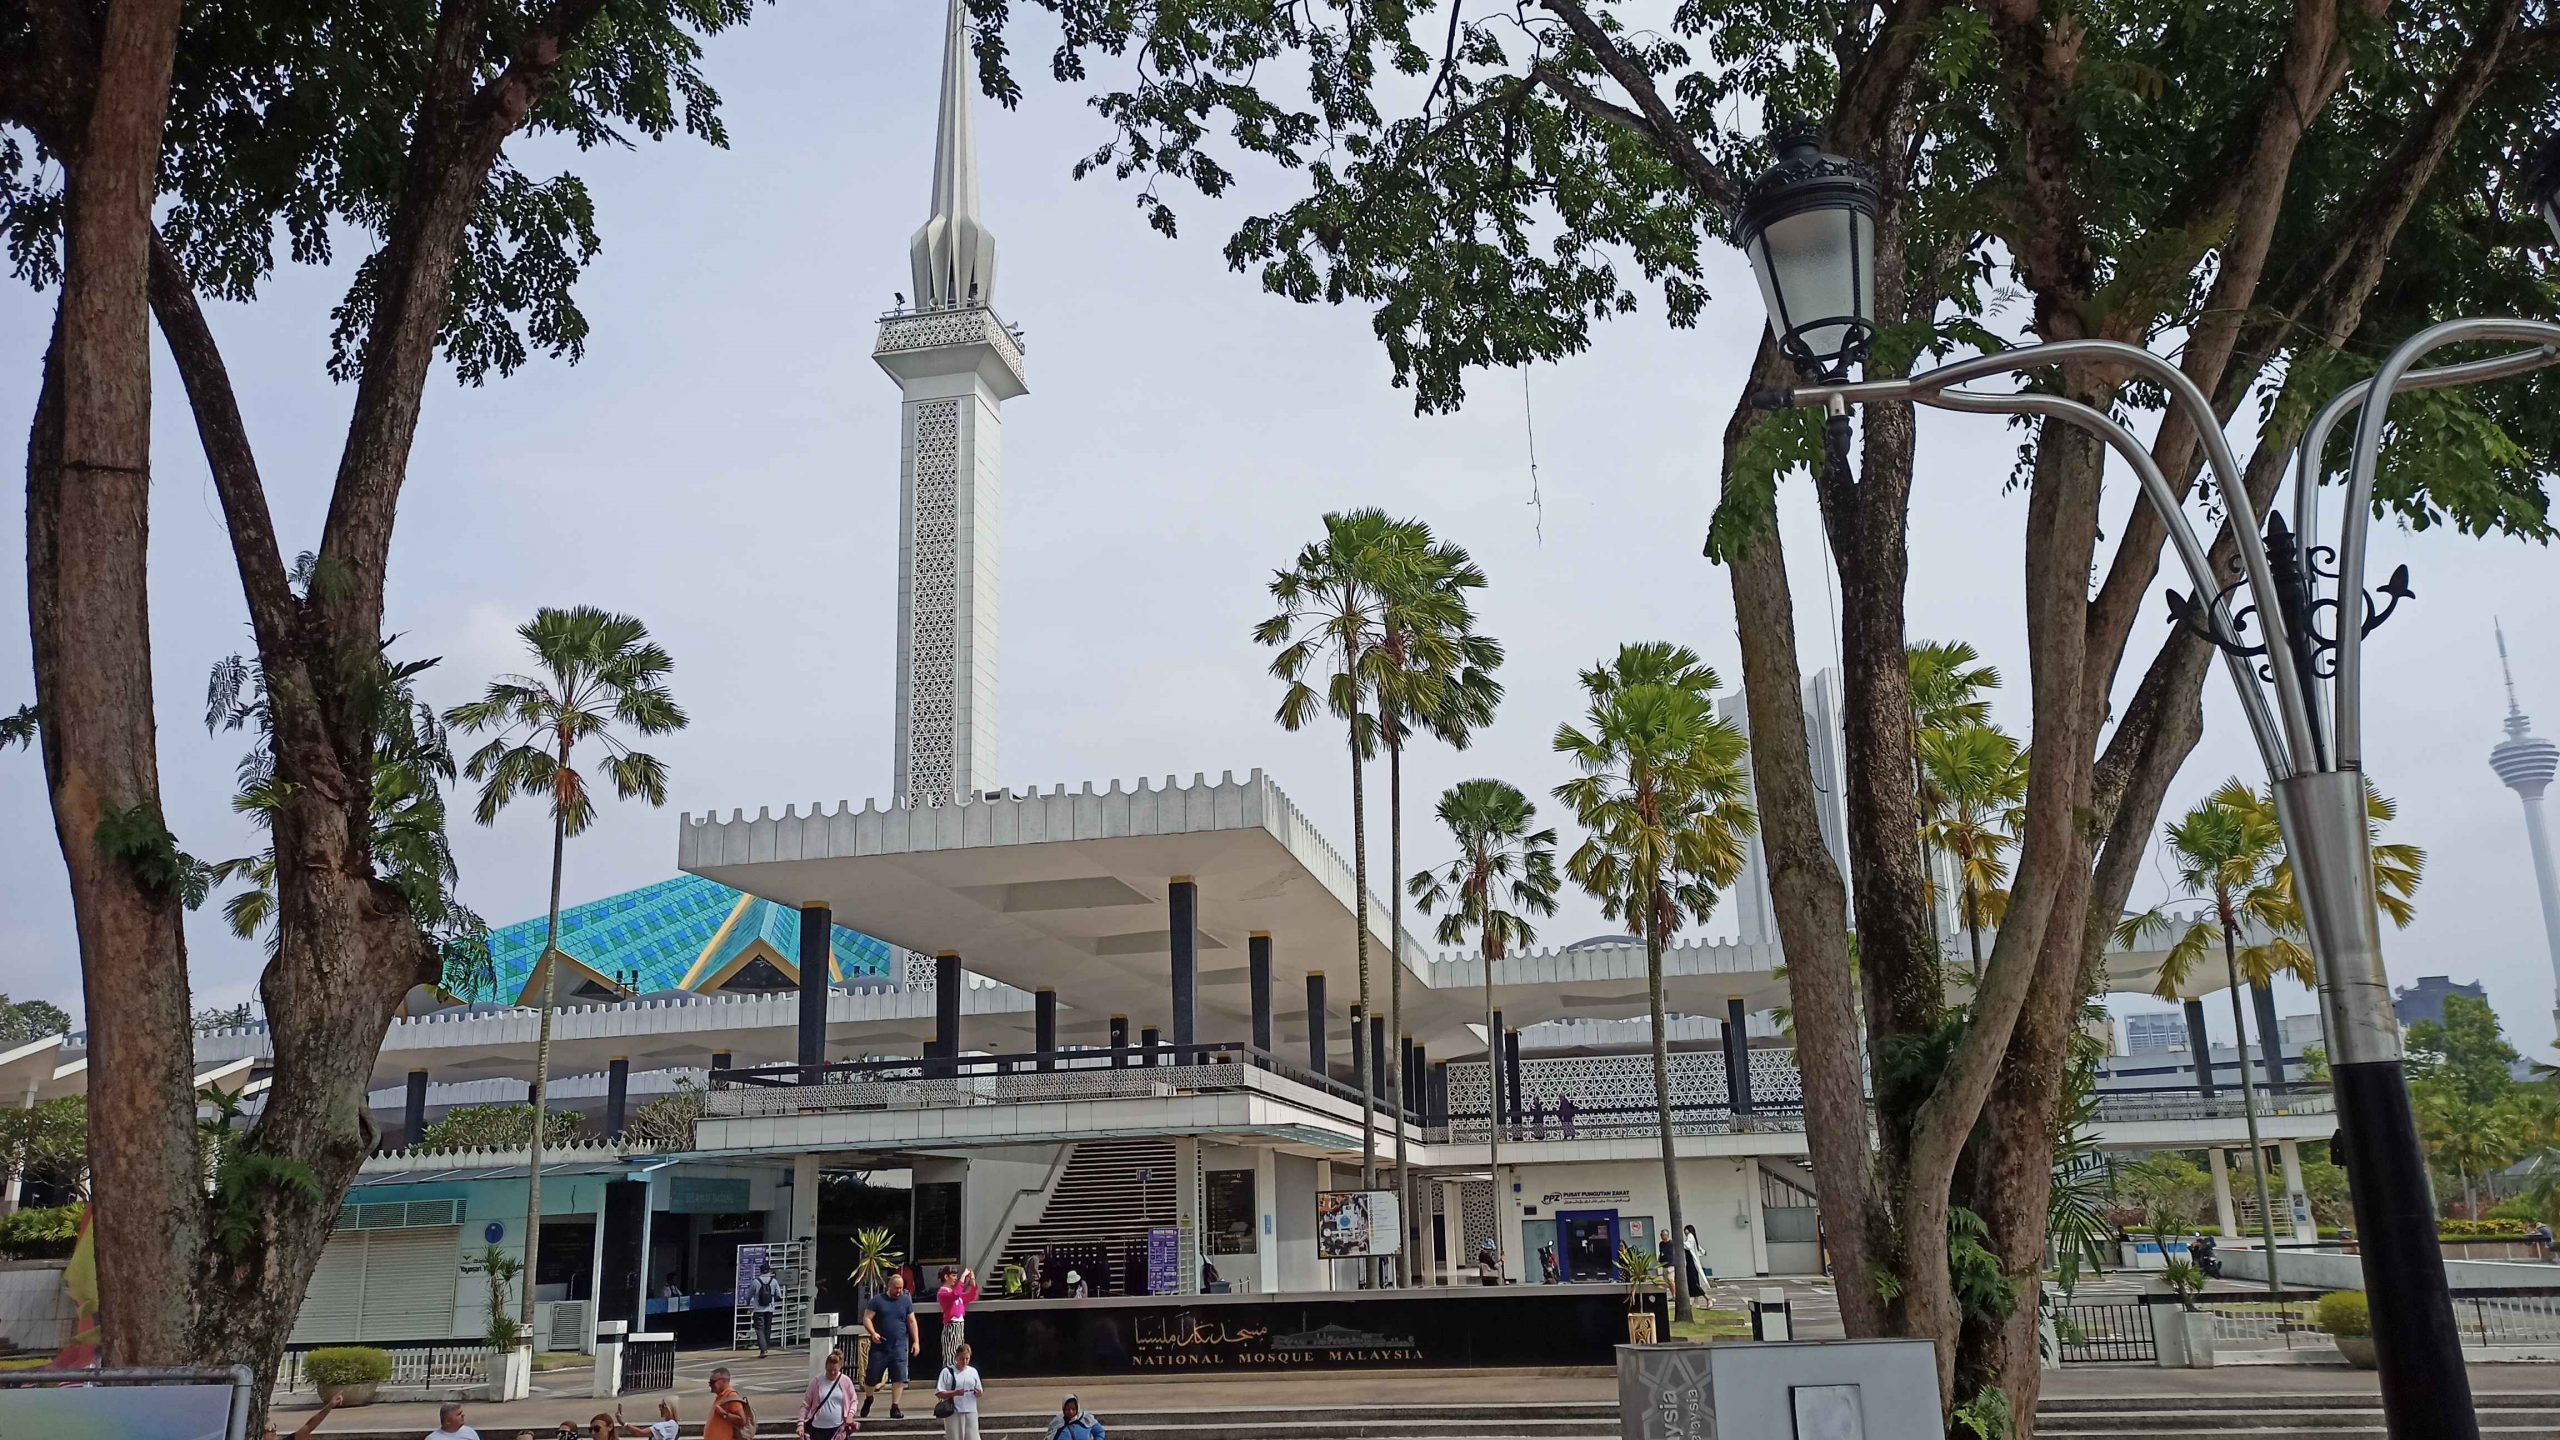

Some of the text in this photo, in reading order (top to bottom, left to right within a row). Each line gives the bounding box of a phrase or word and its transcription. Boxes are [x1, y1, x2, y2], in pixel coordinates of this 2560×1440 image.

[1132, 1349, 1424, 1366] NATIONAL MOSQUE MALAYSIA
[1659, 1390, 1684, 1440] ysia
